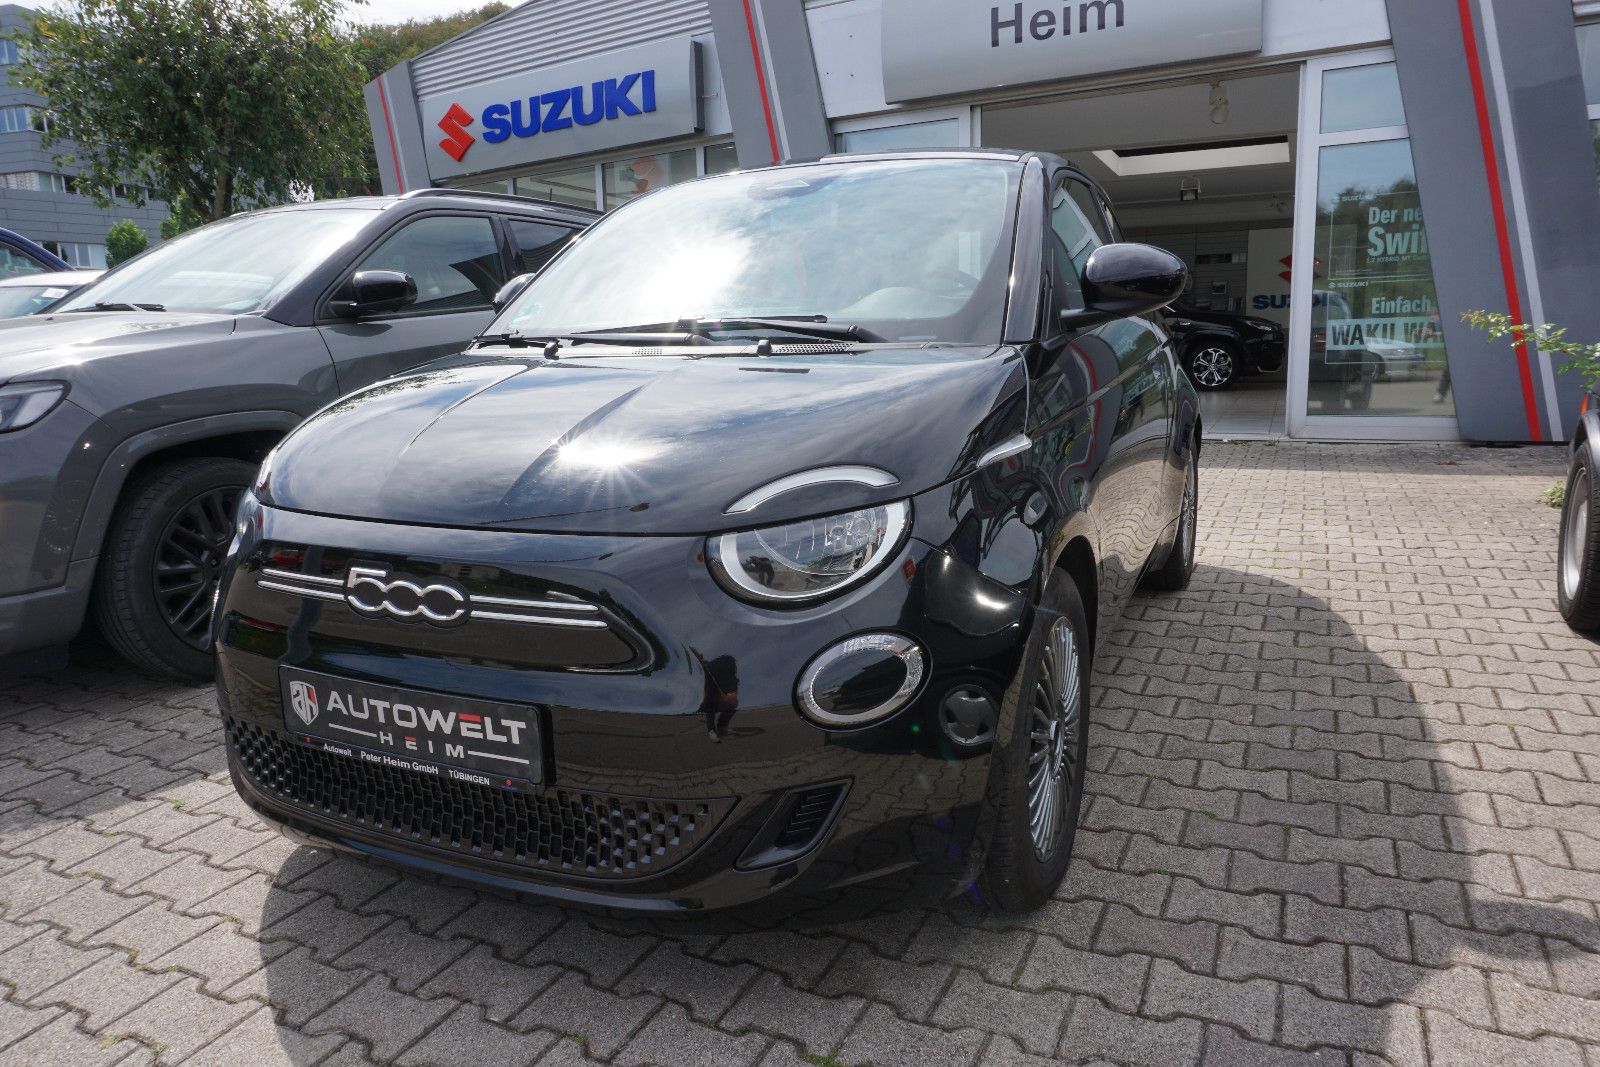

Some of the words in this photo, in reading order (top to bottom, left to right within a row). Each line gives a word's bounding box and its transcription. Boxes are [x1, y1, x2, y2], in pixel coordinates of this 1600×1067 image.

[991, 0, 1124, 47] Heim
[482, 70, 656, 143] SUZUKI
[1368, 206, 1398, 225] Der
[1371, 296, 1431, 314] Einfach
[347, 567, 464, 621] 500
[327, 690, 526, 745] AUTOWELT
[379, 731, 465, 759] HEIM
[361, 750, 381, 763] Peter
[383, 756, 411, 770] Heim
[412, 761, 439, 775] GmbH
[448, 769, 490, 786] TÜBINGEN
